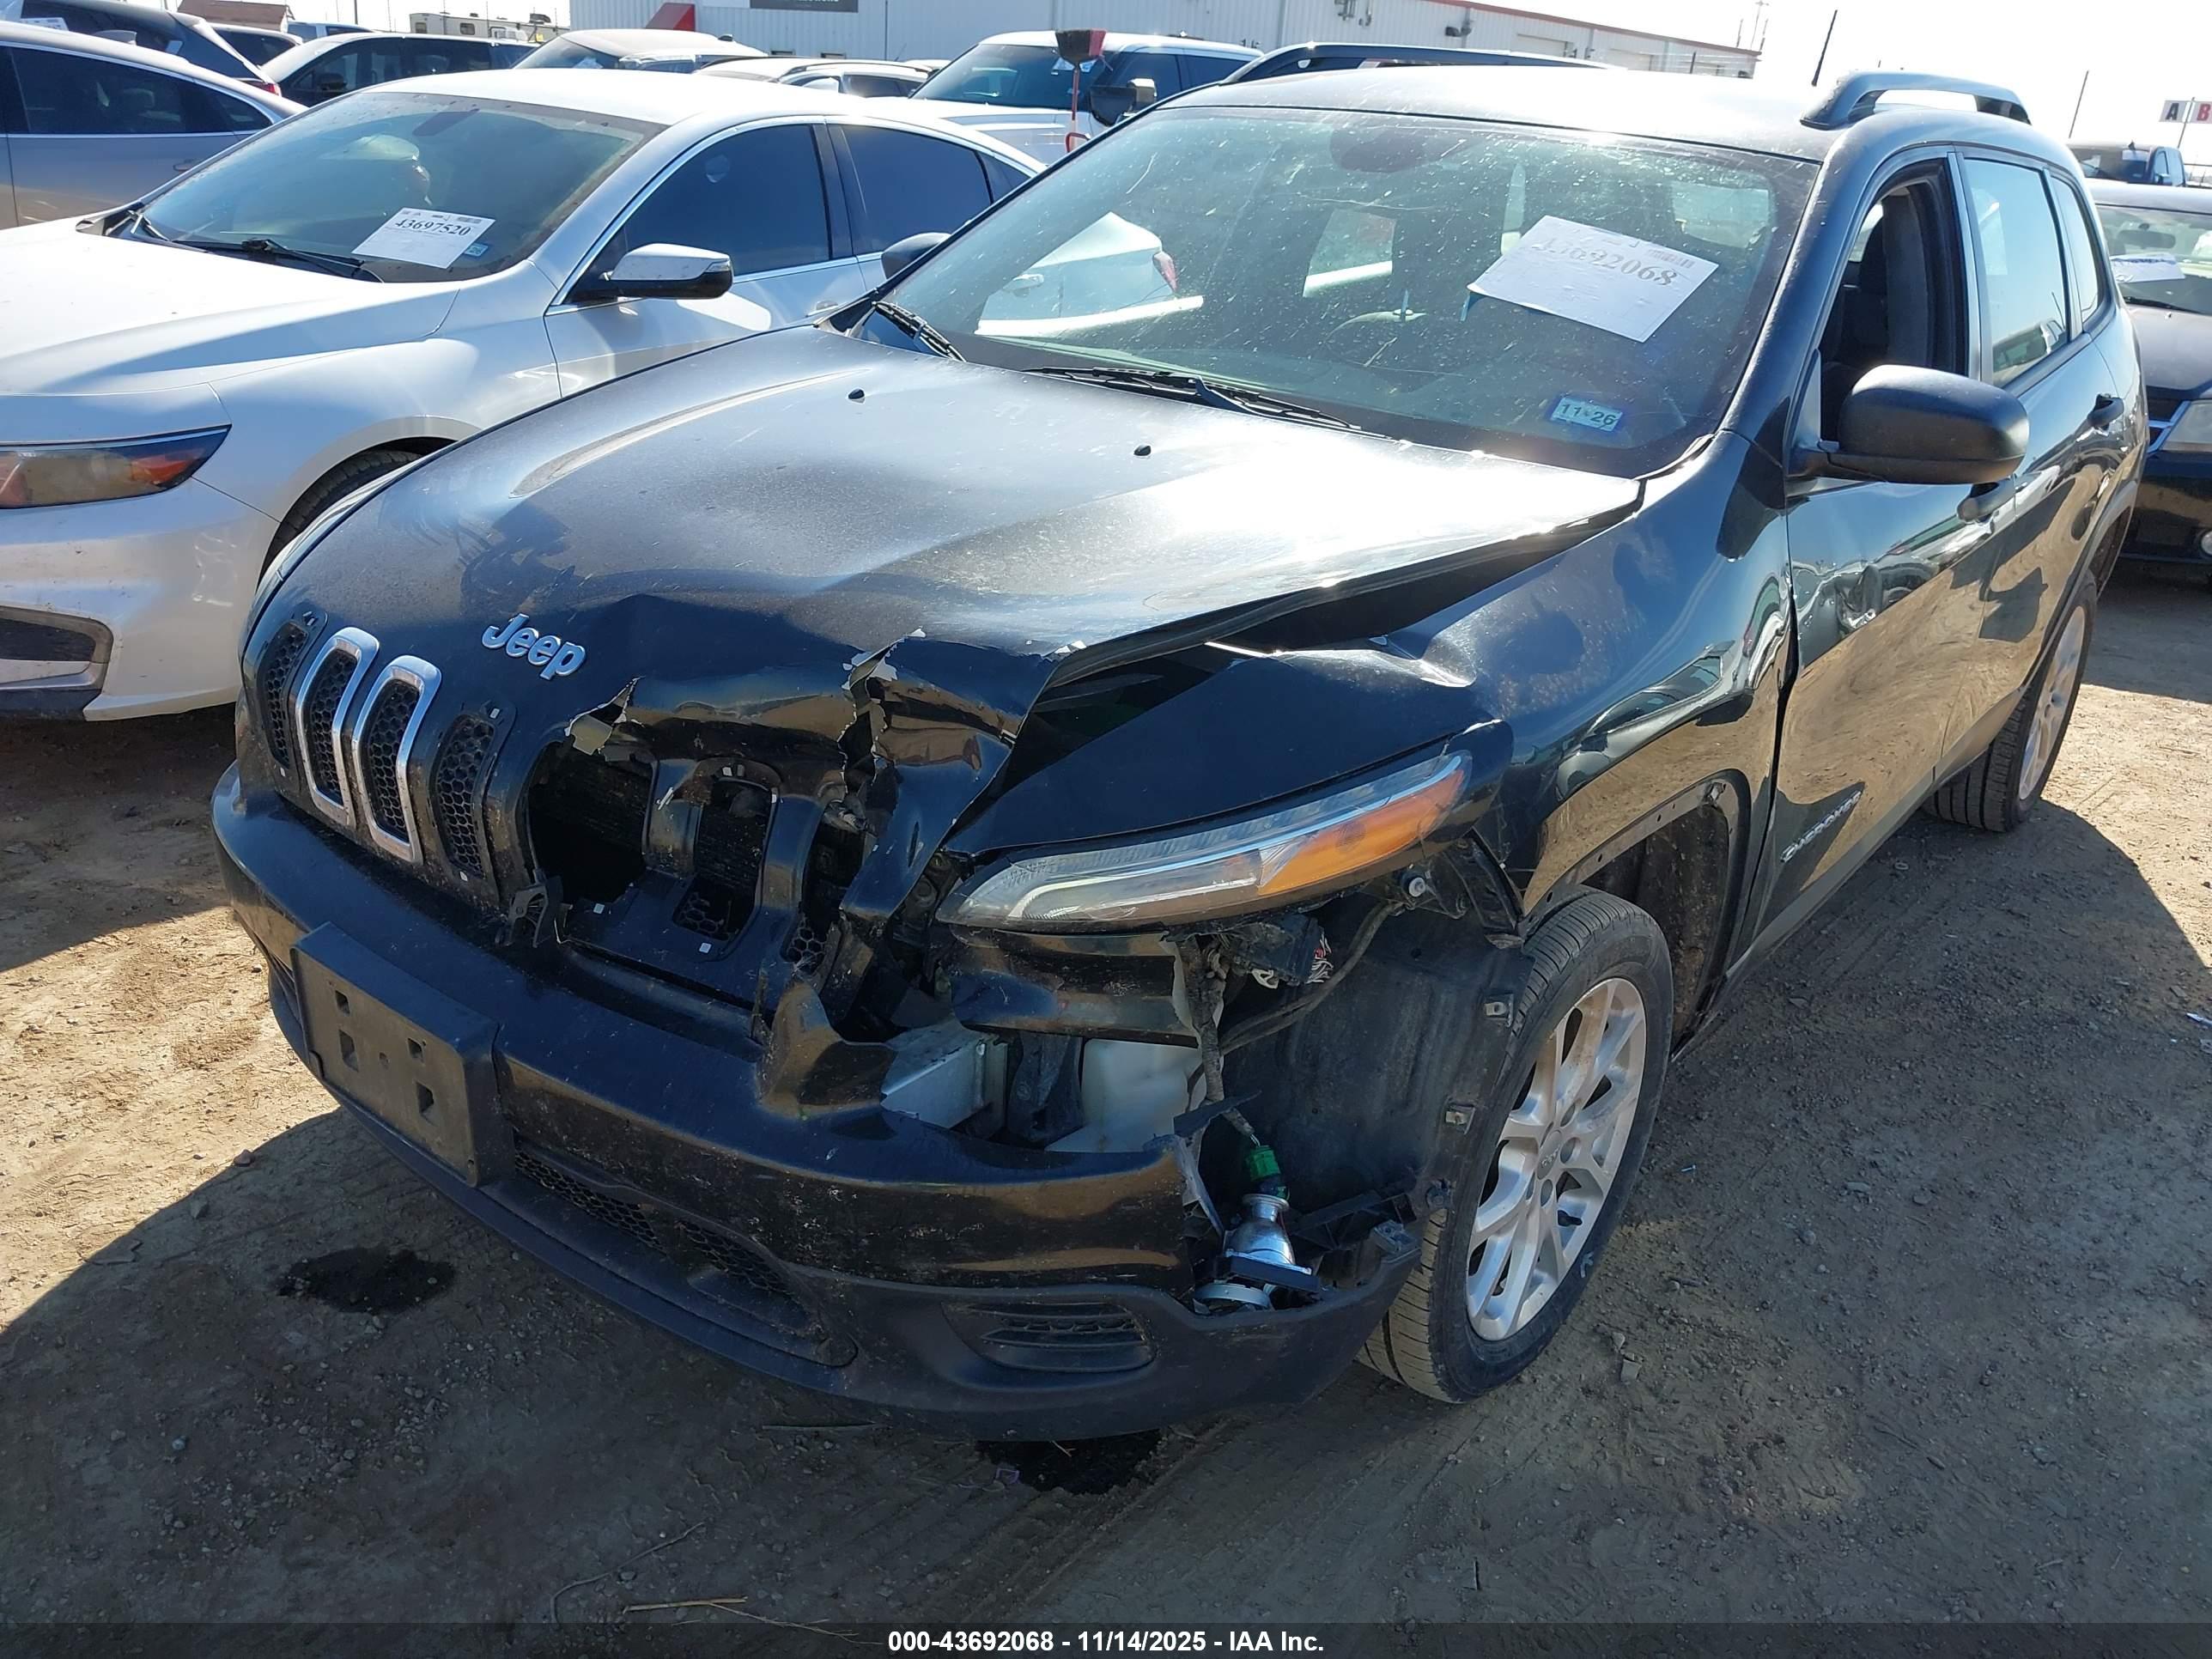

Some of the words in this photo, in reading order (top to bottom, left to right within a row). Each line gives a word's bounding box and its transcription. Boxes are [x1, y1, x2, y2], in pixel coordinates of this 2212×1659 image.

[2165, 102, 2179, 120] A
[2197, 103, 2211, 121] B
[395, 218, 471, 236] 43697520
[1562, 404, 1582, 416] 11
[1590, 411, 1616, 425] 26
[482, 613, 586, 681] Jeep
